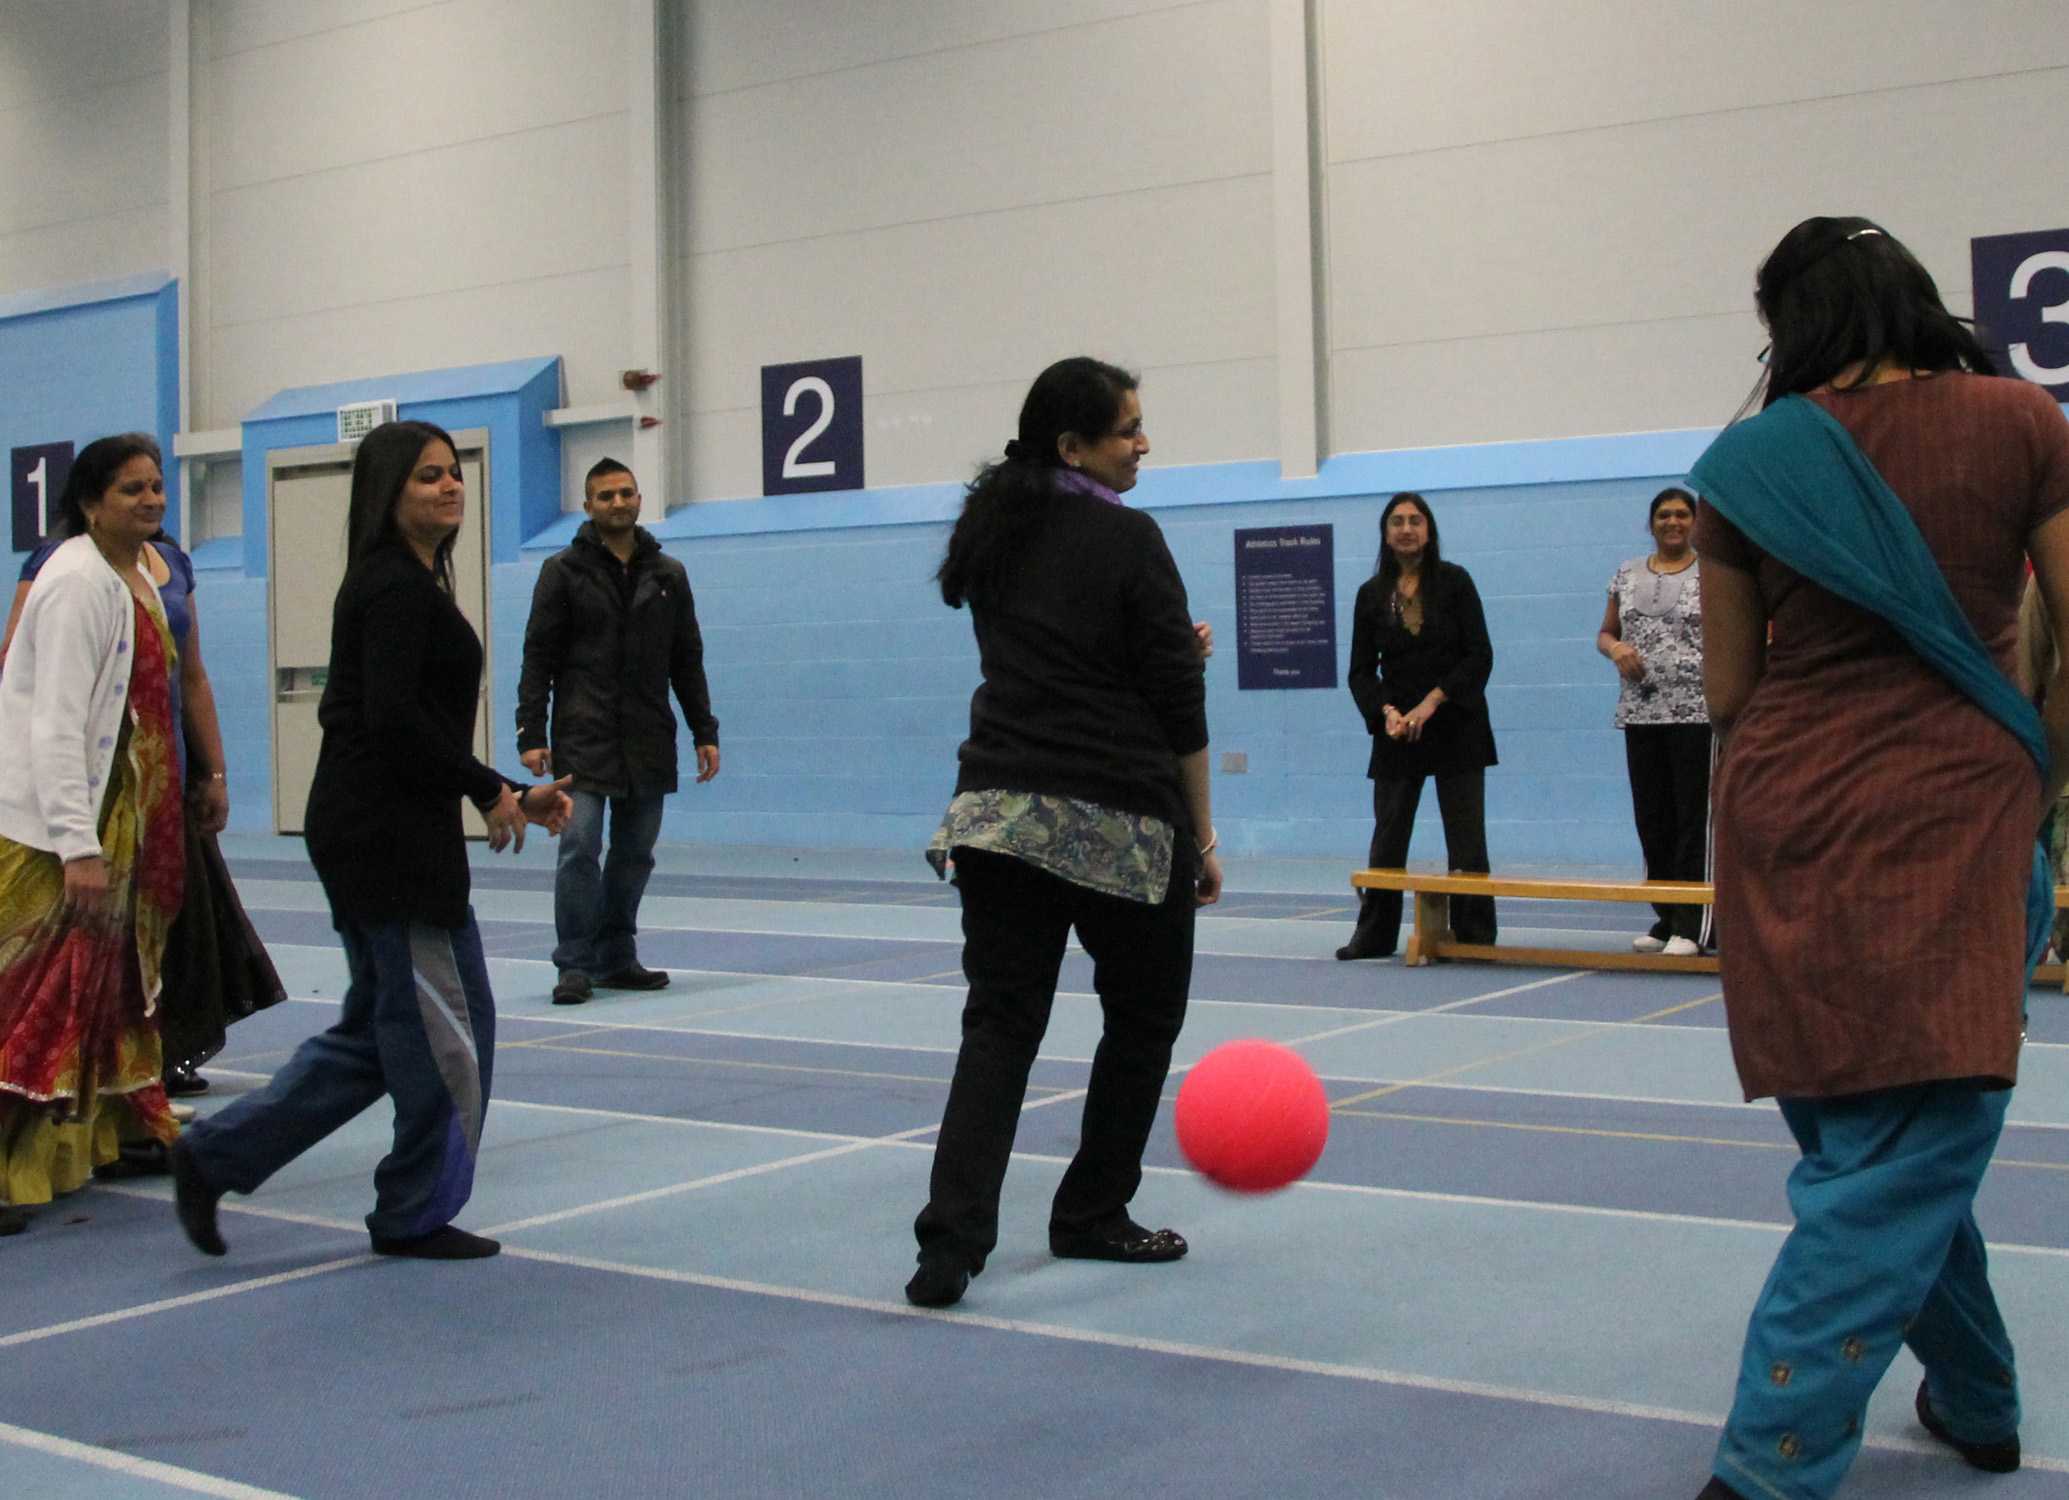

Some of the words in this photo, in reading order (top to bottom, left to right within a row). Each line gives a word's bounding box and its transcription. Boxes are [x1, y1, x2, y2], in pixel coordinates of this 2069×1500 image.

[2008, 251, 2069, 385] 3
[783, 376, 836, 478] 2
[27, 457, 47, 537] 1
[1279, 537, 1298, 547] Track
[1300, 536, 1321, 545] Rules
